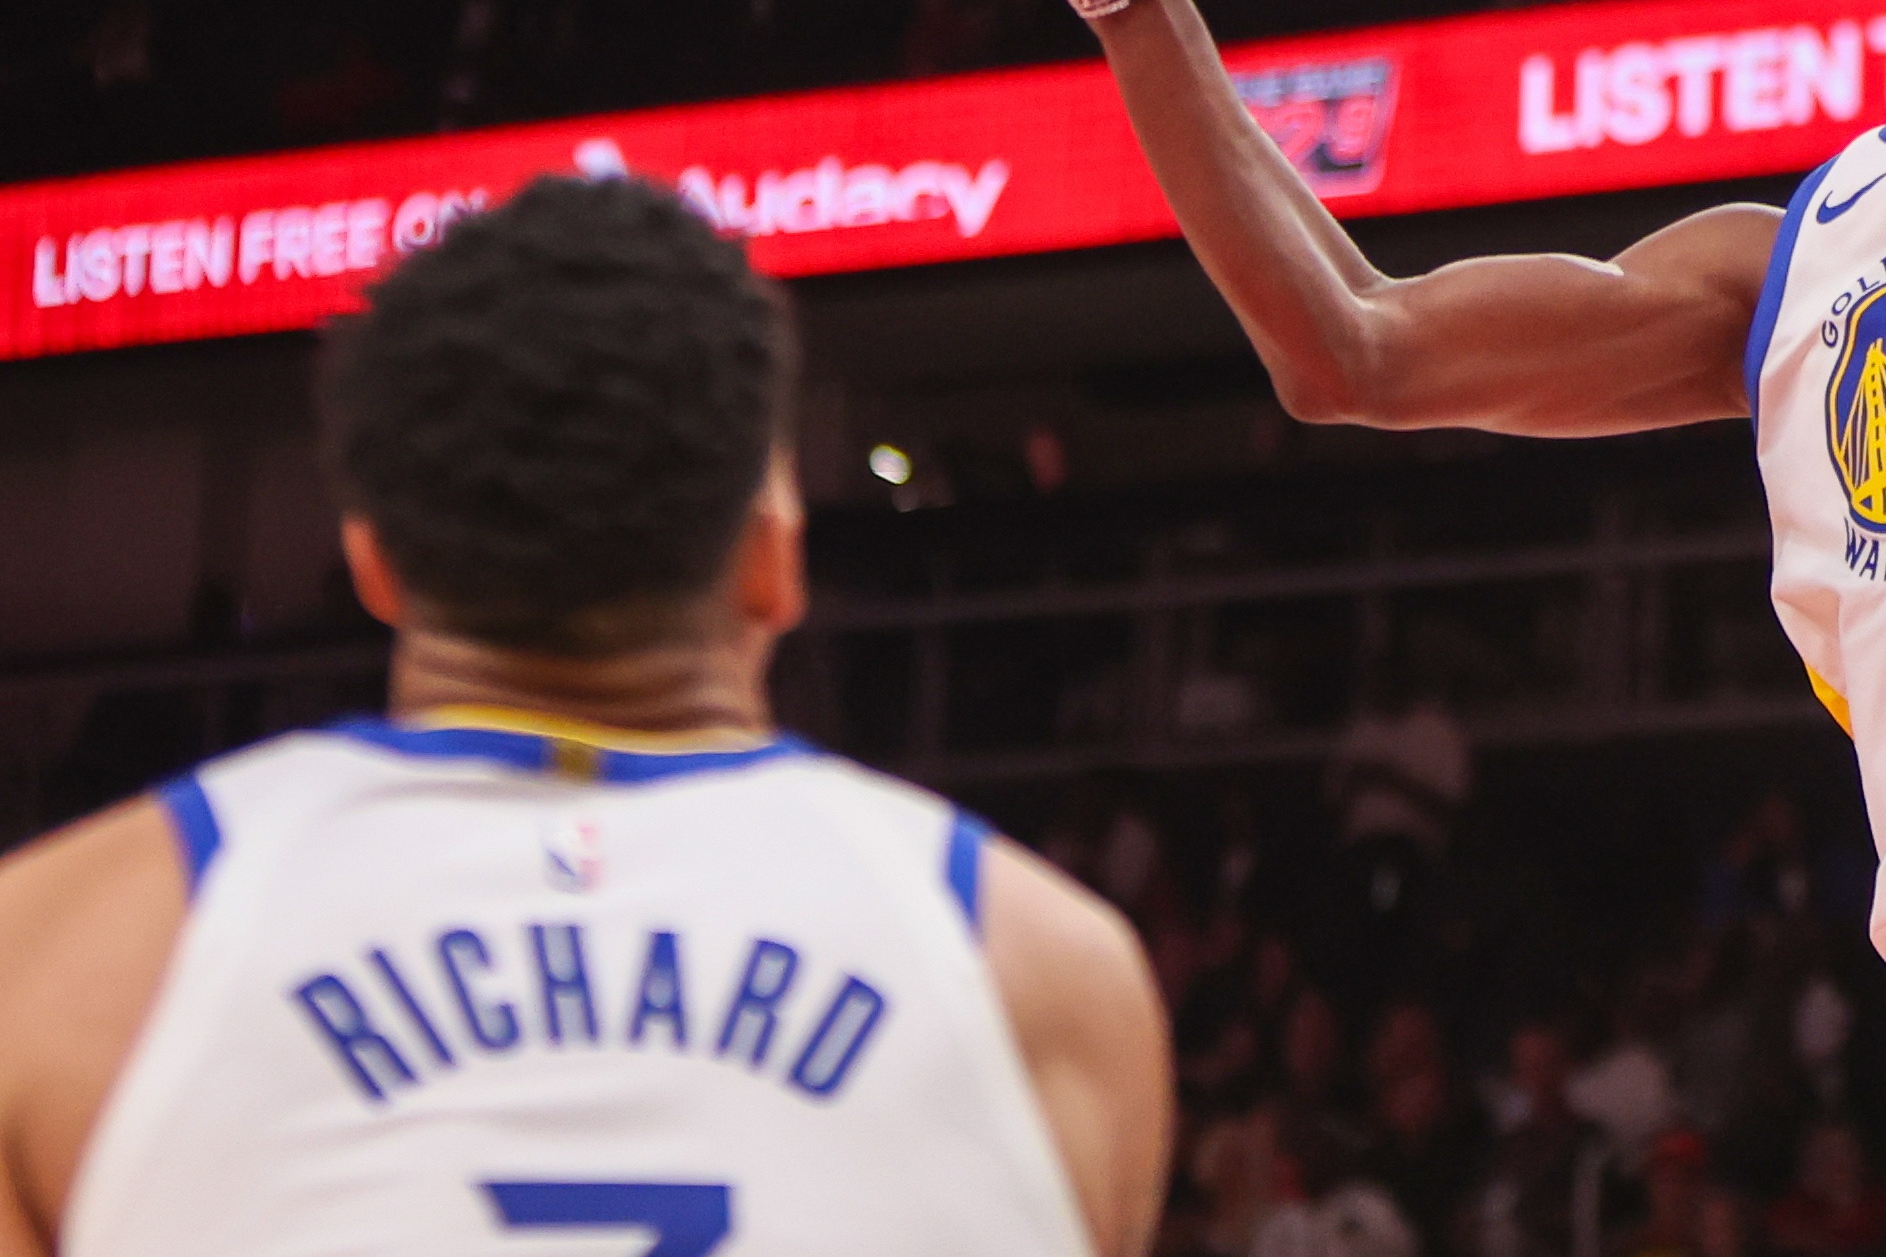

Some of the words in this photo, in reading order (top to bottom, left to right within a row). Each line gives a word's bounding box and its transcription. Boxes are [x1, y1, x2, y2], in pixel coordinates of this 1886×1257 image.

[1518, 20, 1863, 155] LISTEN
[34, 215, 236, 308] LISTEN
[238, 198, 391, 286] FREE
[290, 921, 887, 1103] RICHARD
